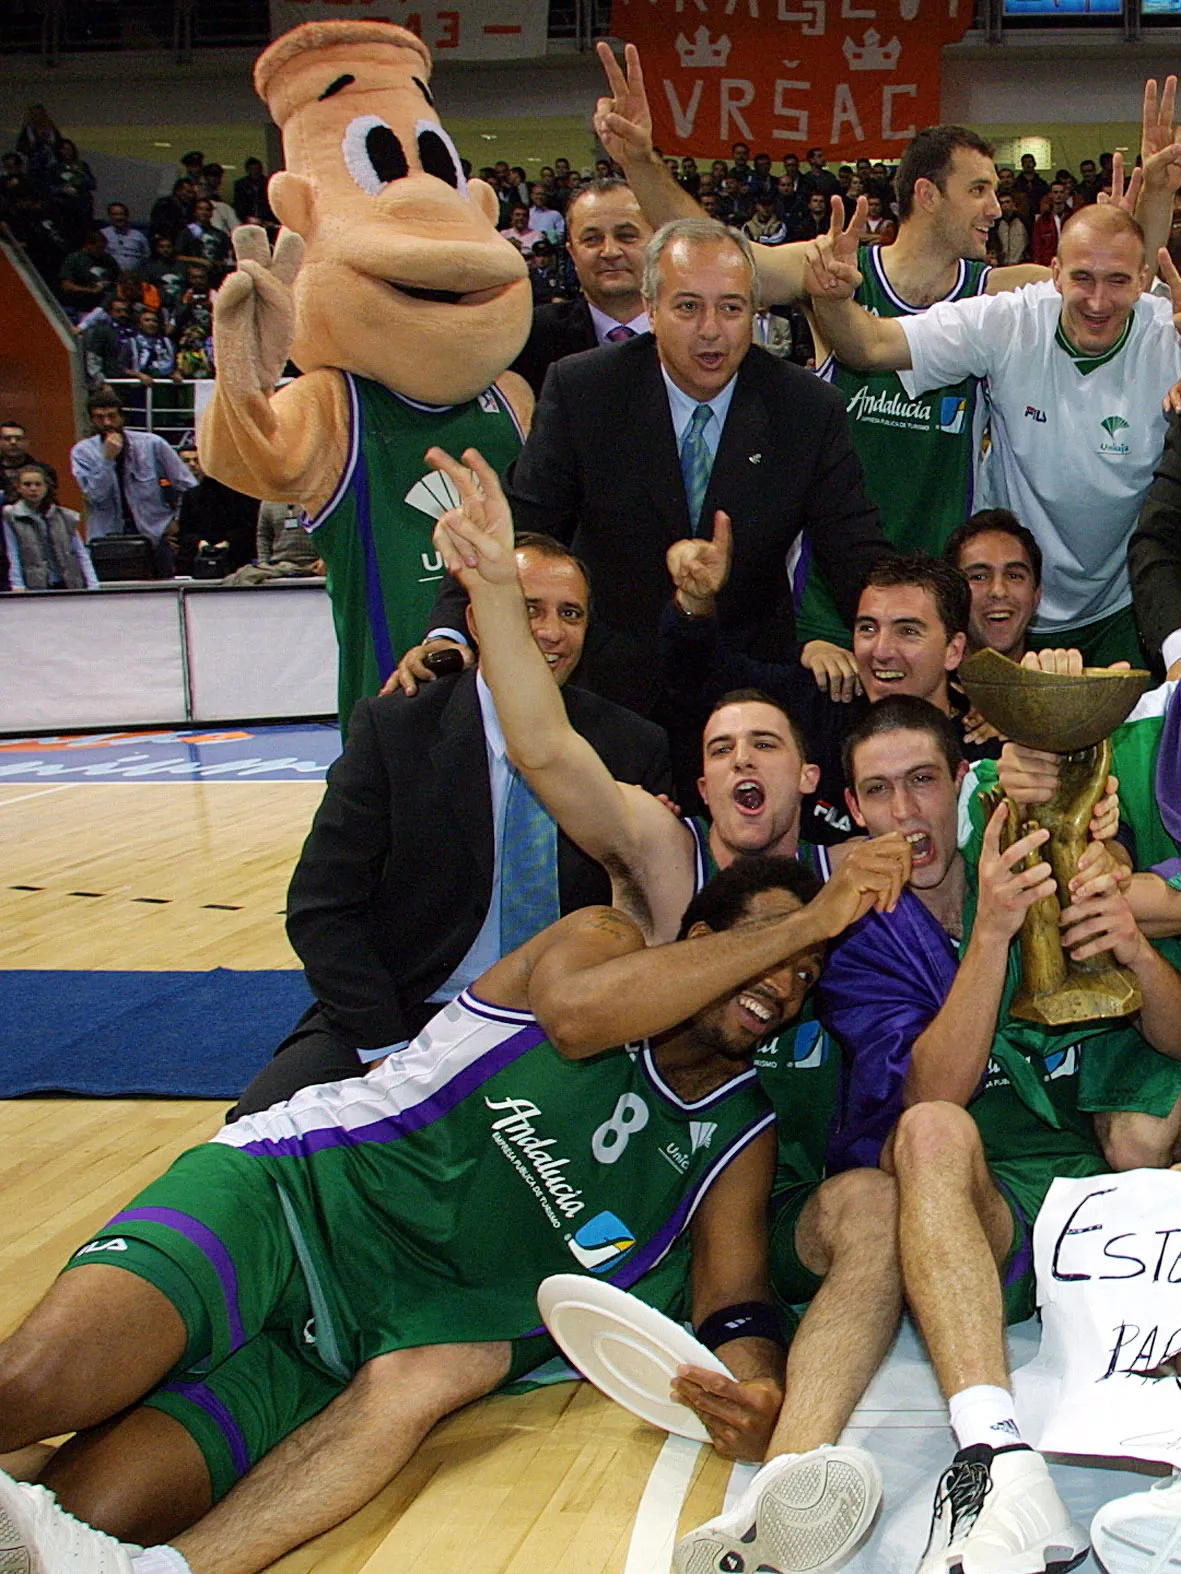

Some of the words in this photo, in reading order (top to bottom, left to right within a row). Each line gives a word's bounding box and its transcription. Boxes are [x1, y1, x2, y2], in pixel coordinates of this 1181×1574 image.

[663, 60, 918, 144] VRŠAC
[813, 800, 852, 832] FILA
[591, 1092, 650, 1164] 8
